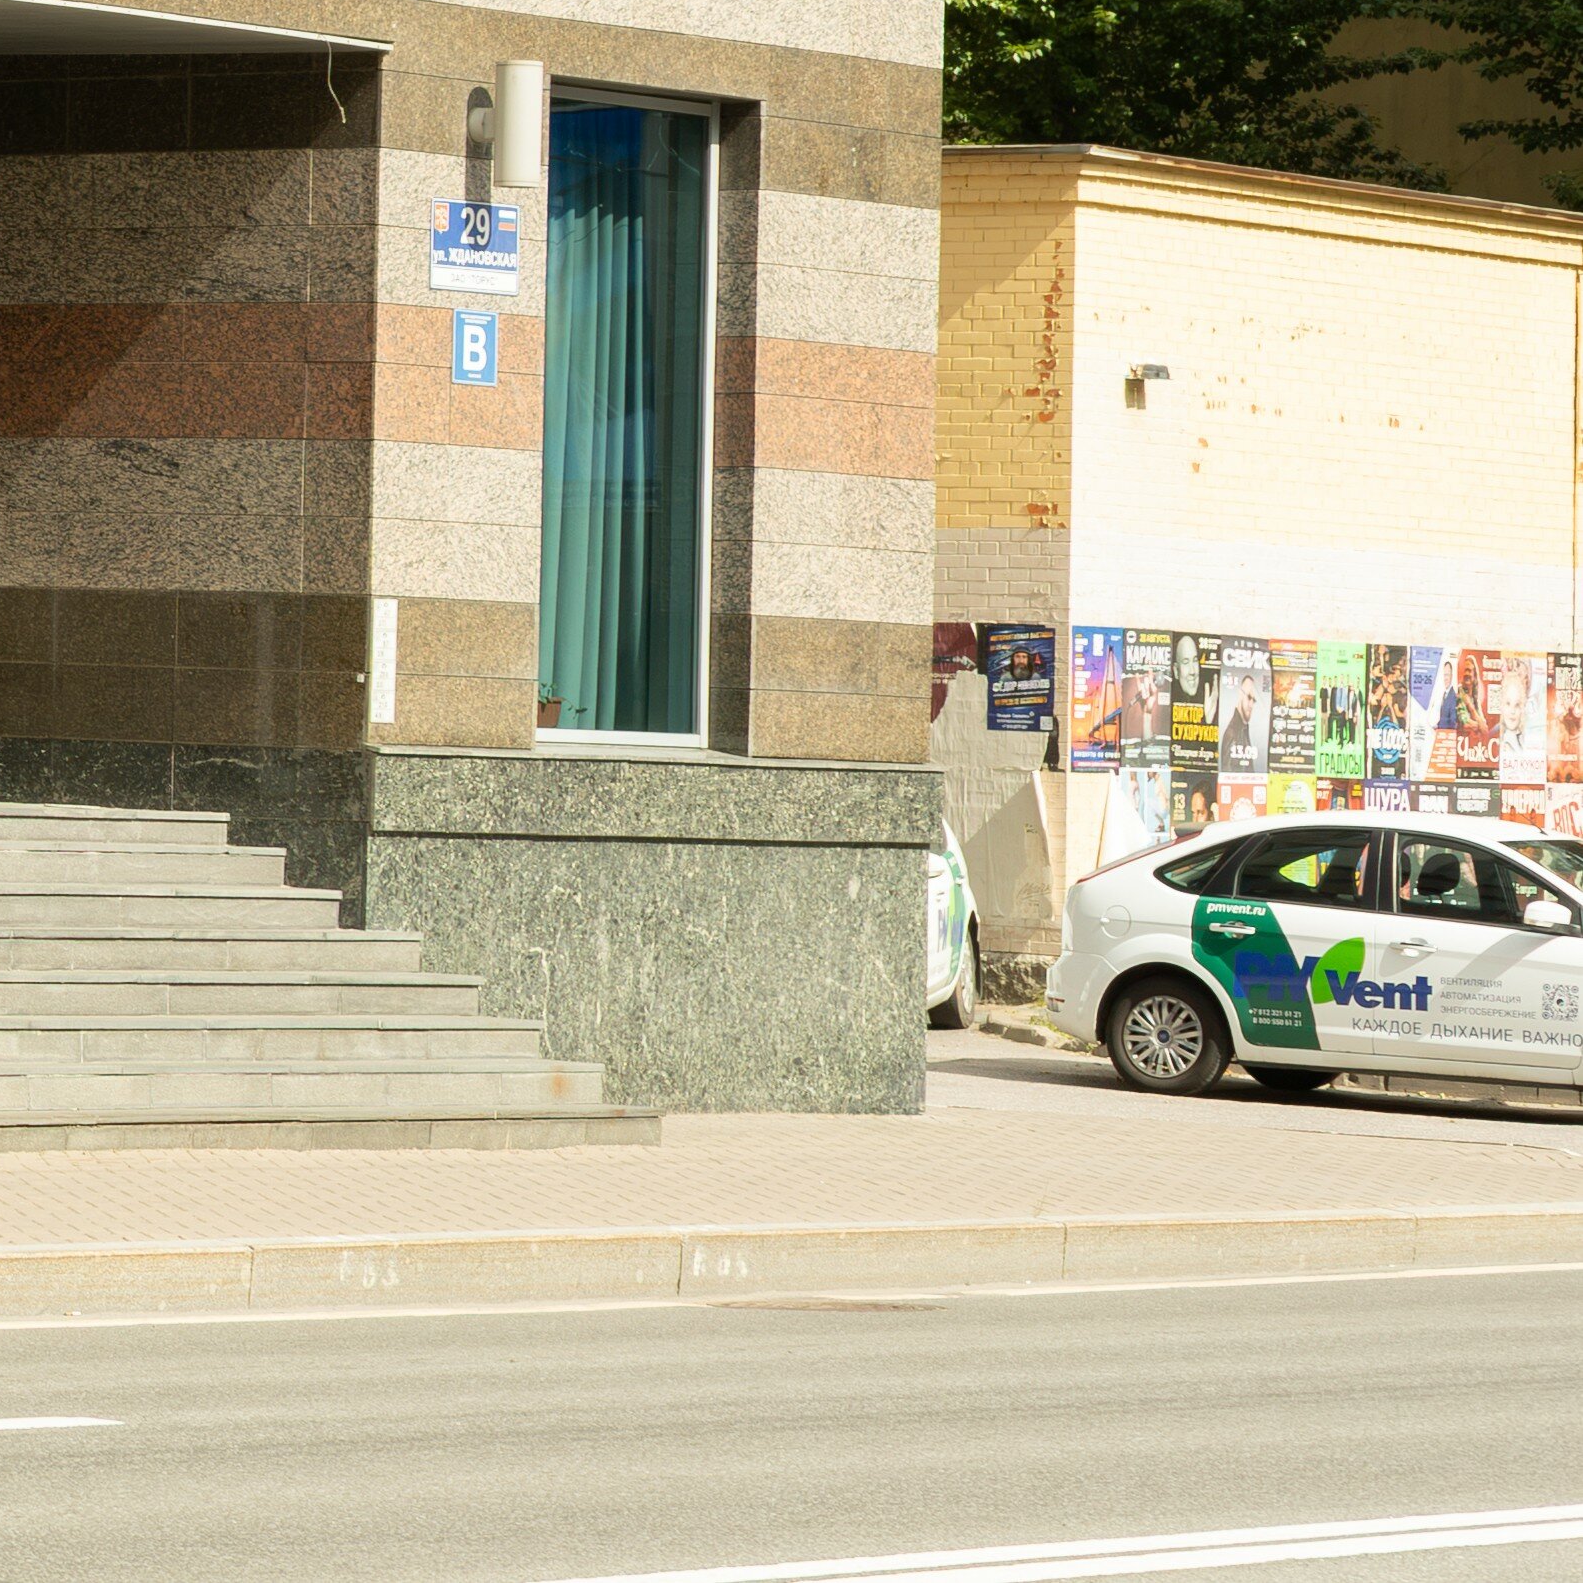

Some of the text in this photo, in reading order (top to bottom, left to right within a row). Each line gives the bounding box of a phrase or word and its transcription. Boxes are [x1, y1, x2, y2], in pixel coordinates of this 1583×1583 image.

[460, 206, 490, 246] 29
[448, 247, 517, 268] ЖДАНОВСКАЯ
[1126, 645, 1171, 666] КАРАОКЕ
[1222, 648, 1271, 670] СВИК
[1172, 705, 1204, 723] ВИКТОР
[1172, 723, 1219, 742] СУХОРУКОВ
[1319, 753, 1362, 775] ГРАДУСЫ
[1365, 787, 1411, 812] ШУРА
[1206, 902, 1266, 916] pmvent.ru
[1440, 976, 1502, 988] ВЕНТИЛЯЦИЯ
[1439, 991, 1522, 1004] АВТОМАТИЗАЦИЯ
[1440, 1005, 1537, 1019] ЭНЕРГОСБЕРЕЖЕНИЕ
[1352, 1017, 1583, 1048] КАЖДОЕ ДЫХАНИЕ ВАЖНО
